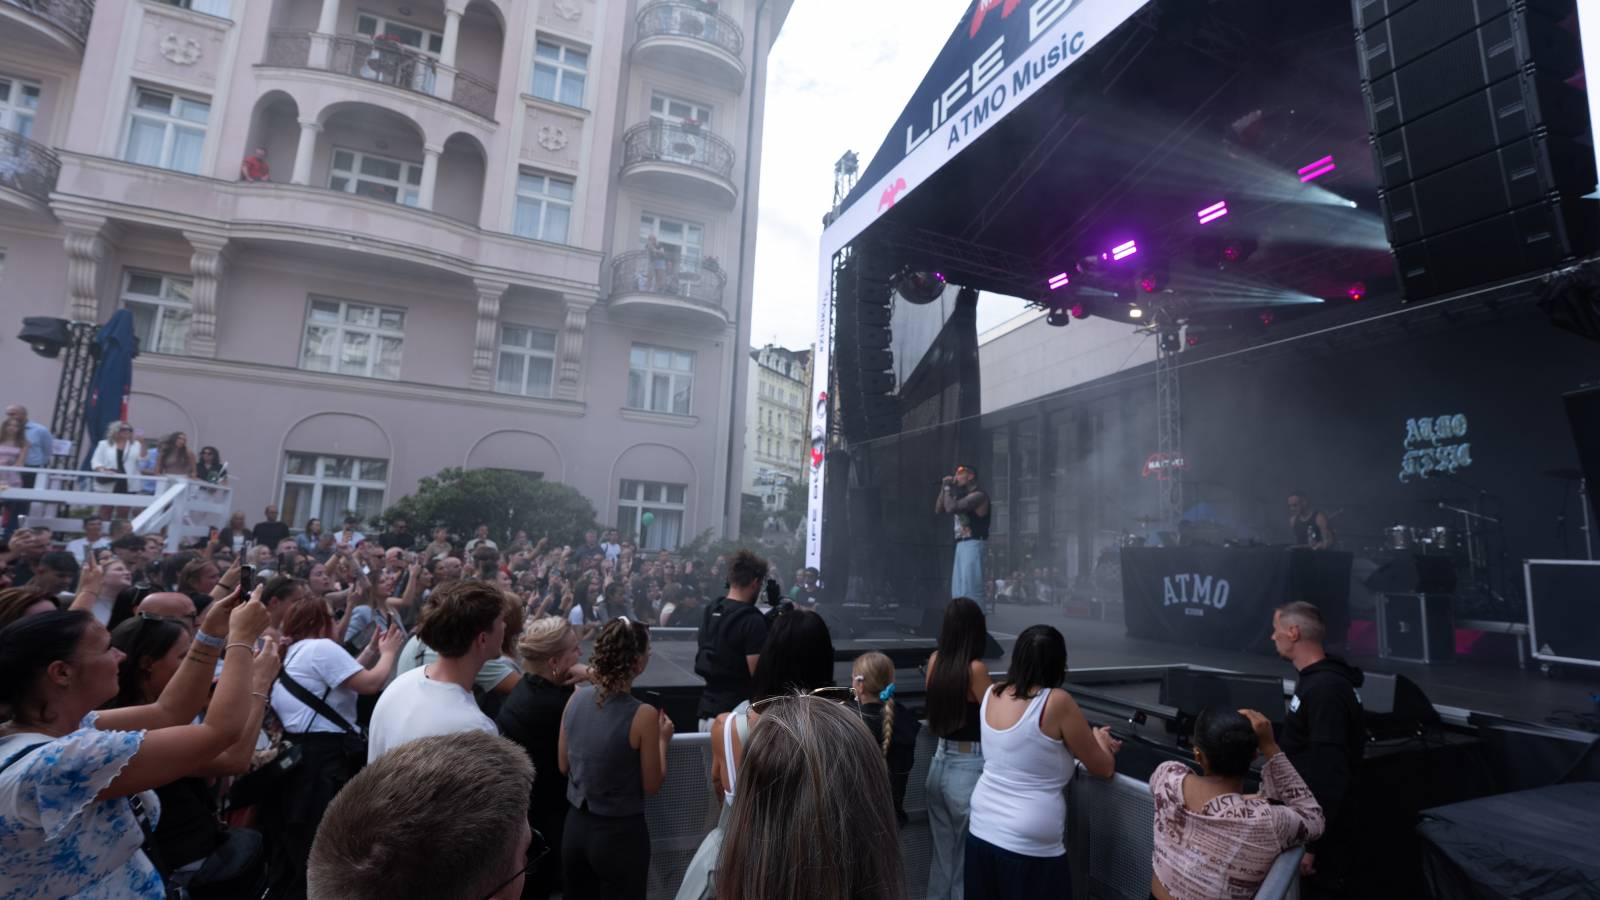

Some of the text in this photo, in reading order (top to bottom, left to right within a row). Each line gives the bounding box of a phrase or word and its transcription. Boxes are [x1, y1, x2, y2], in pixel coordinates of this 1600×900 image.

[905, 35, 1005, 154] LIFE
[947, 31, 1085, 150] ATMO Music
[1163, 573, 1230, 609] ATMO
